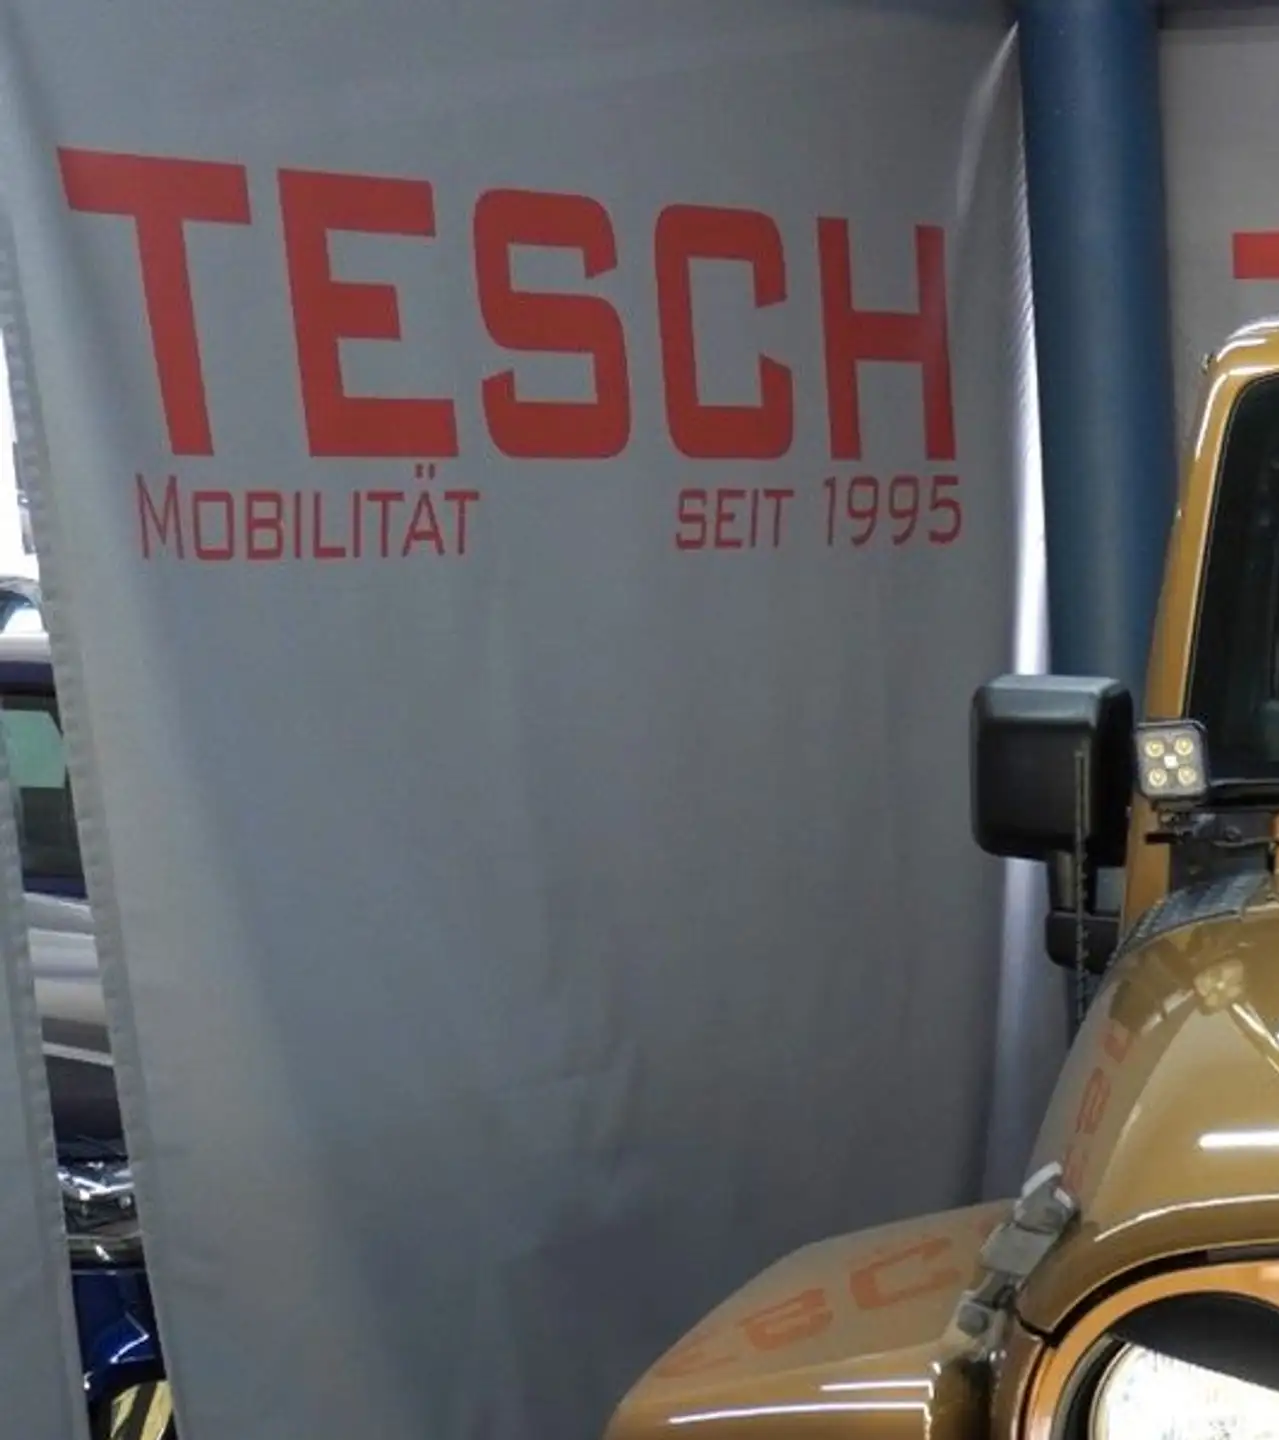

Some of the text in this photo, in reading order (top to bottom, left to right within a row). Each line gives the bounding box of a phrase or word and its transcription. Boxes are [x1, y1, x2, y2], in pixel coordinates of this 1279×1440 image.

[57, 147, 957, 460] TESCH
[674, 487, 794, 550] SEIT
[822, 474, 962, 546] 1995
